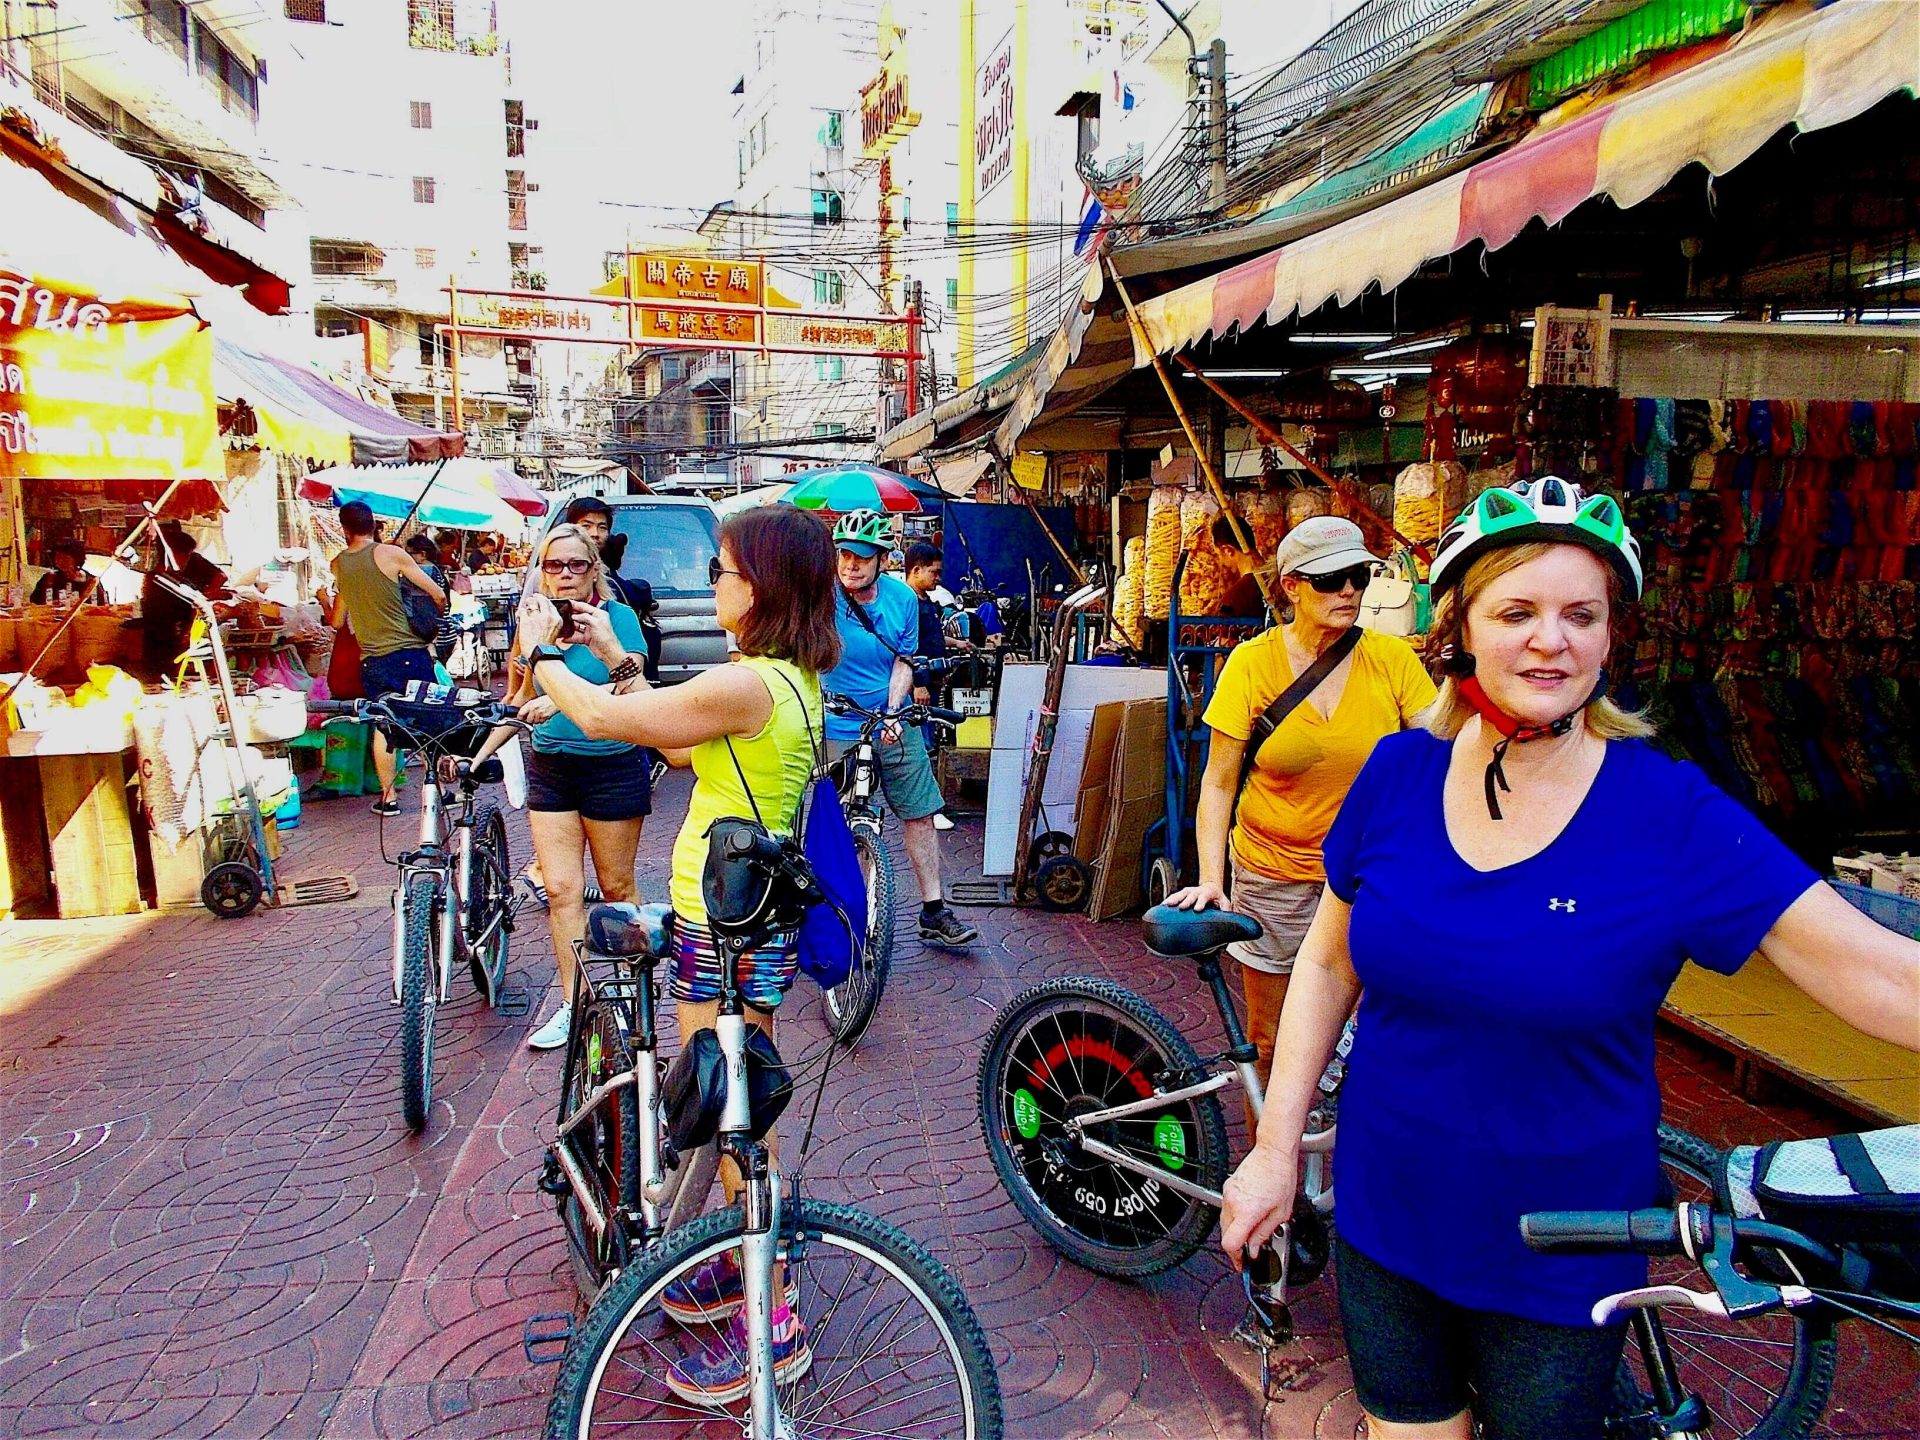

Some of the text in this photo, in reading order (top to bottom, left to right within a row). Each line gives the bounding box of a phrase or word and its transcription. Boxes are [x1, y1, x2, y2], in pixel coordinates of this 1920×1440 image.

[646, 260, 749, 290] 關帝古廟
[655, 310, 743, 335] 馬將軍爺
[1017, 1096, 1029, 1130] Follow
[1029, 1106, 1037, 1124] Me
[1075, 1178, 1160, 1216] all 087 059
